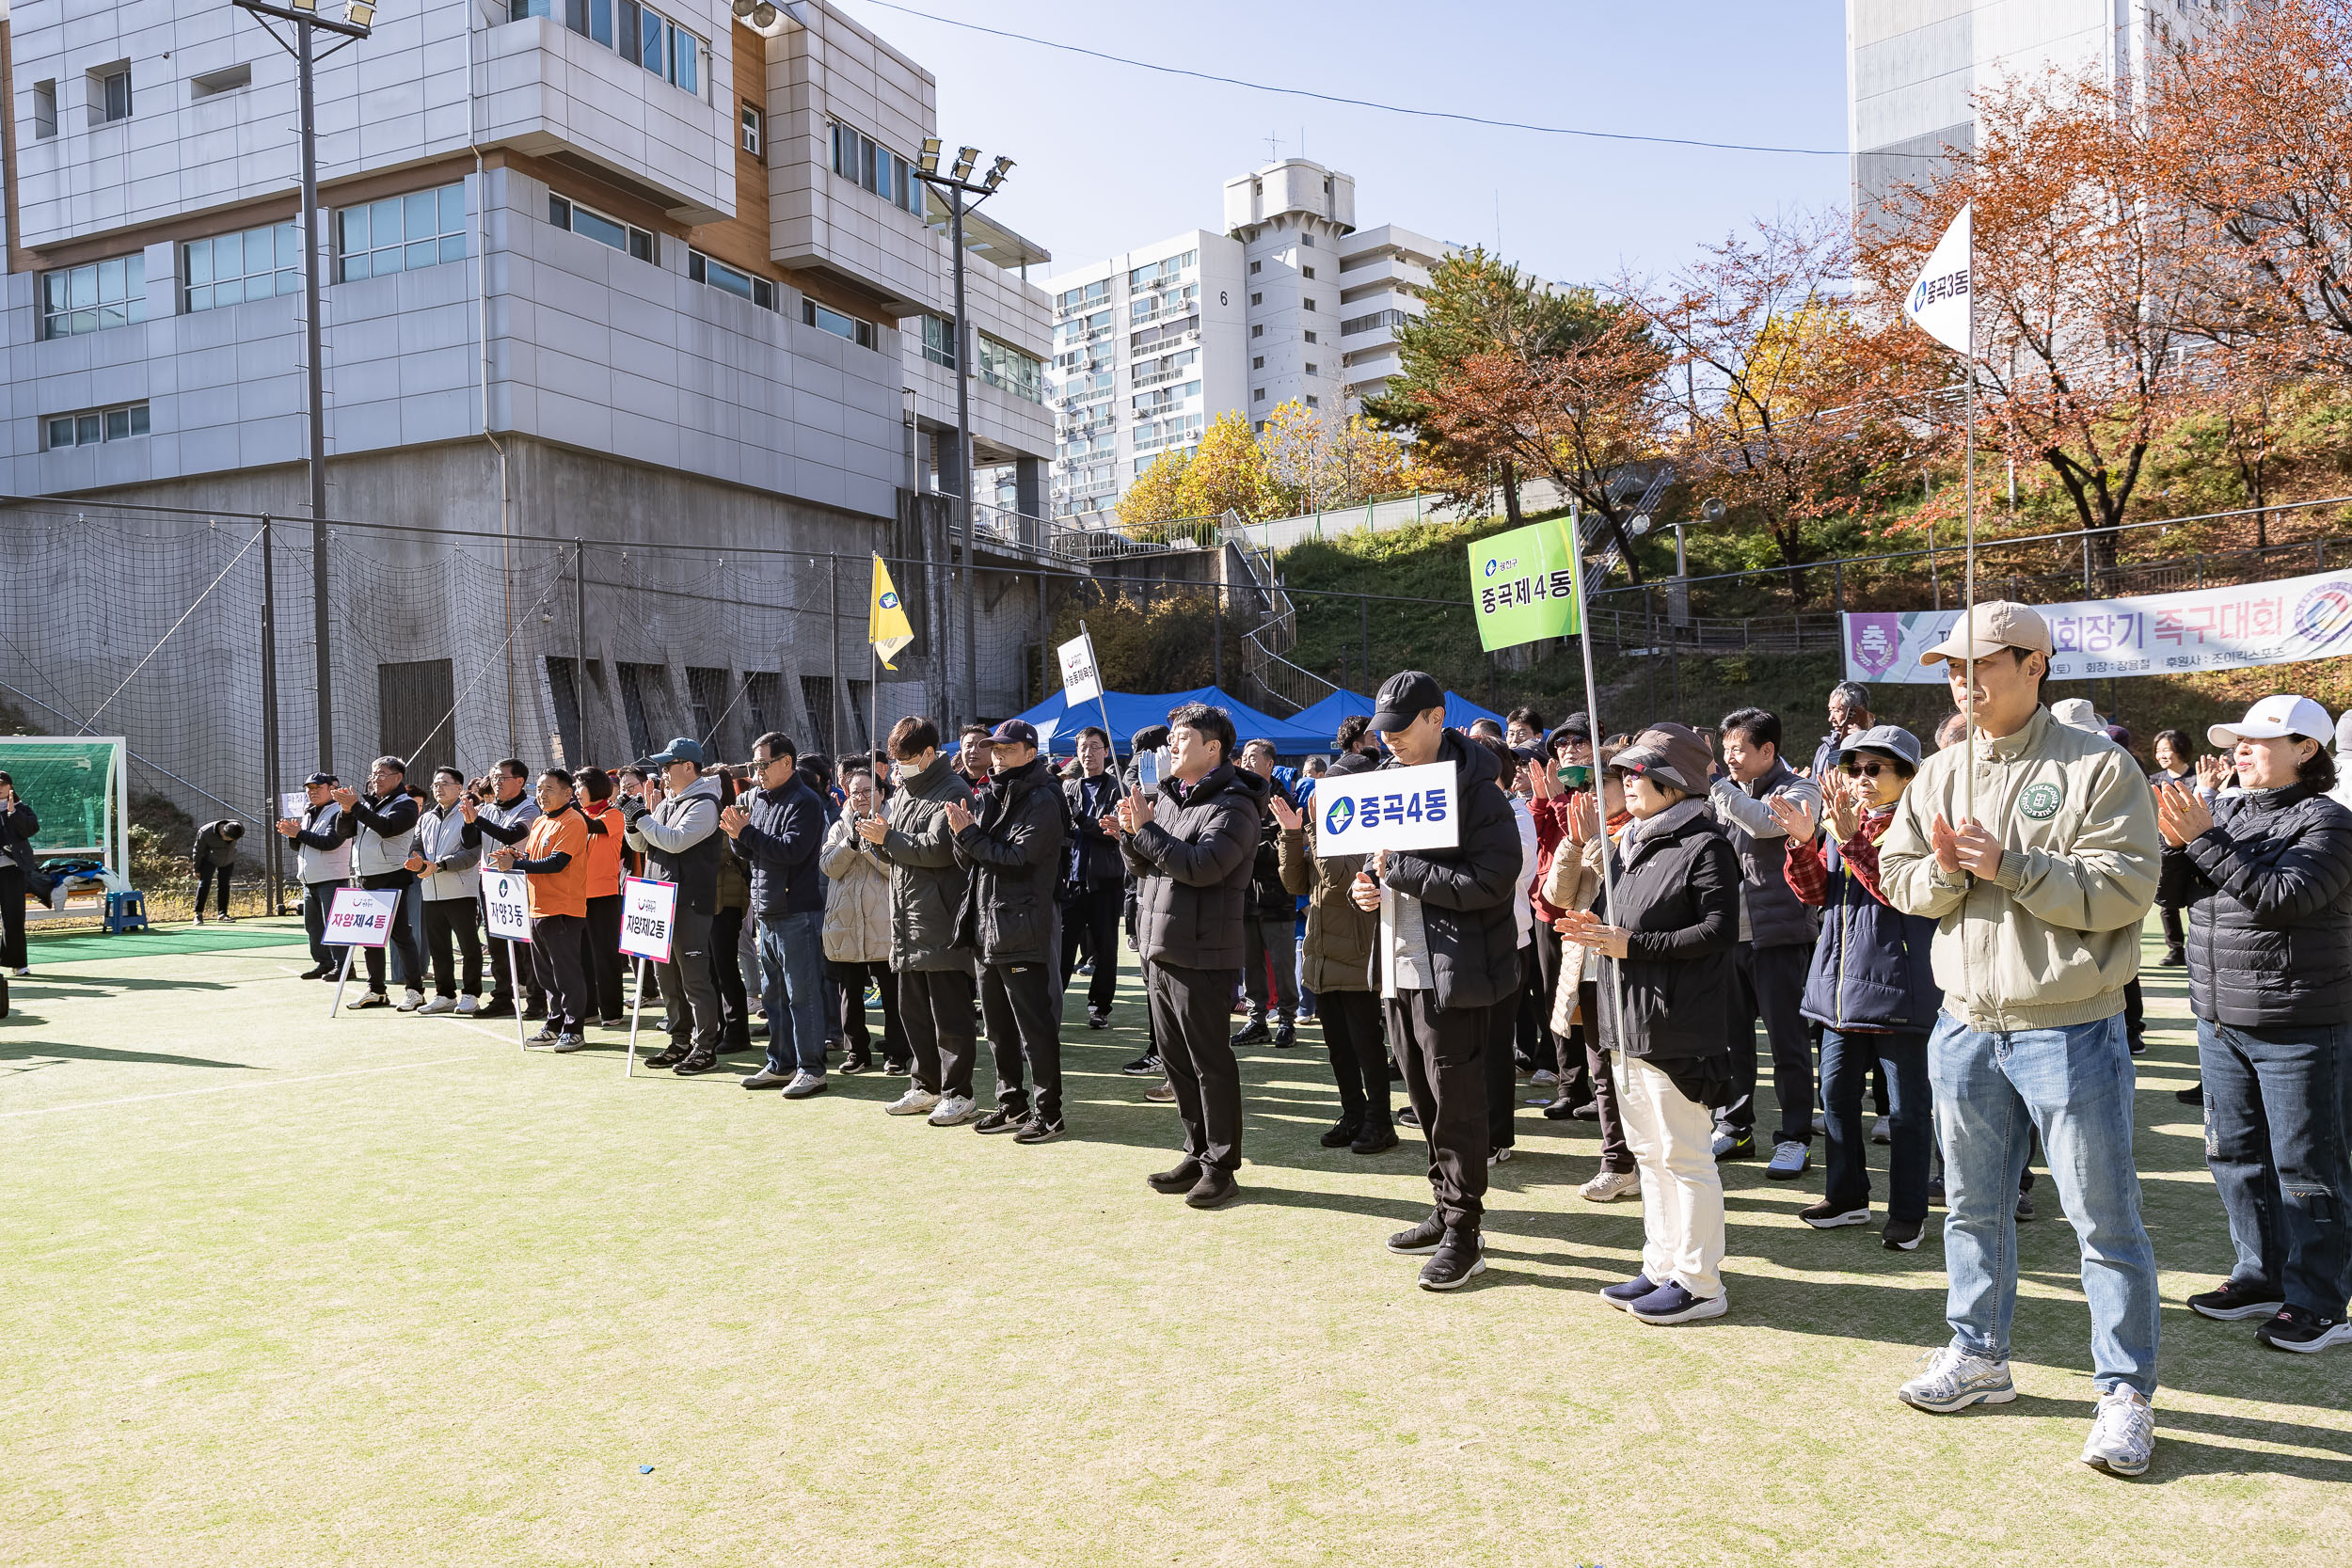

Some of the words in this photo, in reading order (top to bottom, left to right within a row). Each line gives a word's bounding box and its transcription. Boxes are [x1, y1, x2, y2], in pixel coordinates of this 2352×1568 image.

[1220, 291, 1228, 306] 6
[1928, 270, 1968, 305] 중곡3동
[1482, 570, 1572, 613] 중곡제4동
[2050, 611, 2142, 653] 회장기
[2154, 596, 2282, 646] 족구대회
[1861, 625, 1887, 654] 축
[2086, 662, 2107, 673] 회장
[2166, 655, 2201, 668] 후원사
[1359, 788, 1447, 828] 중곡4동
[331, 913, 387, 929] 자양제4동
[490, 902, 523, 927] 자양3동
[627, 914, 665, 939] 자양제2동
